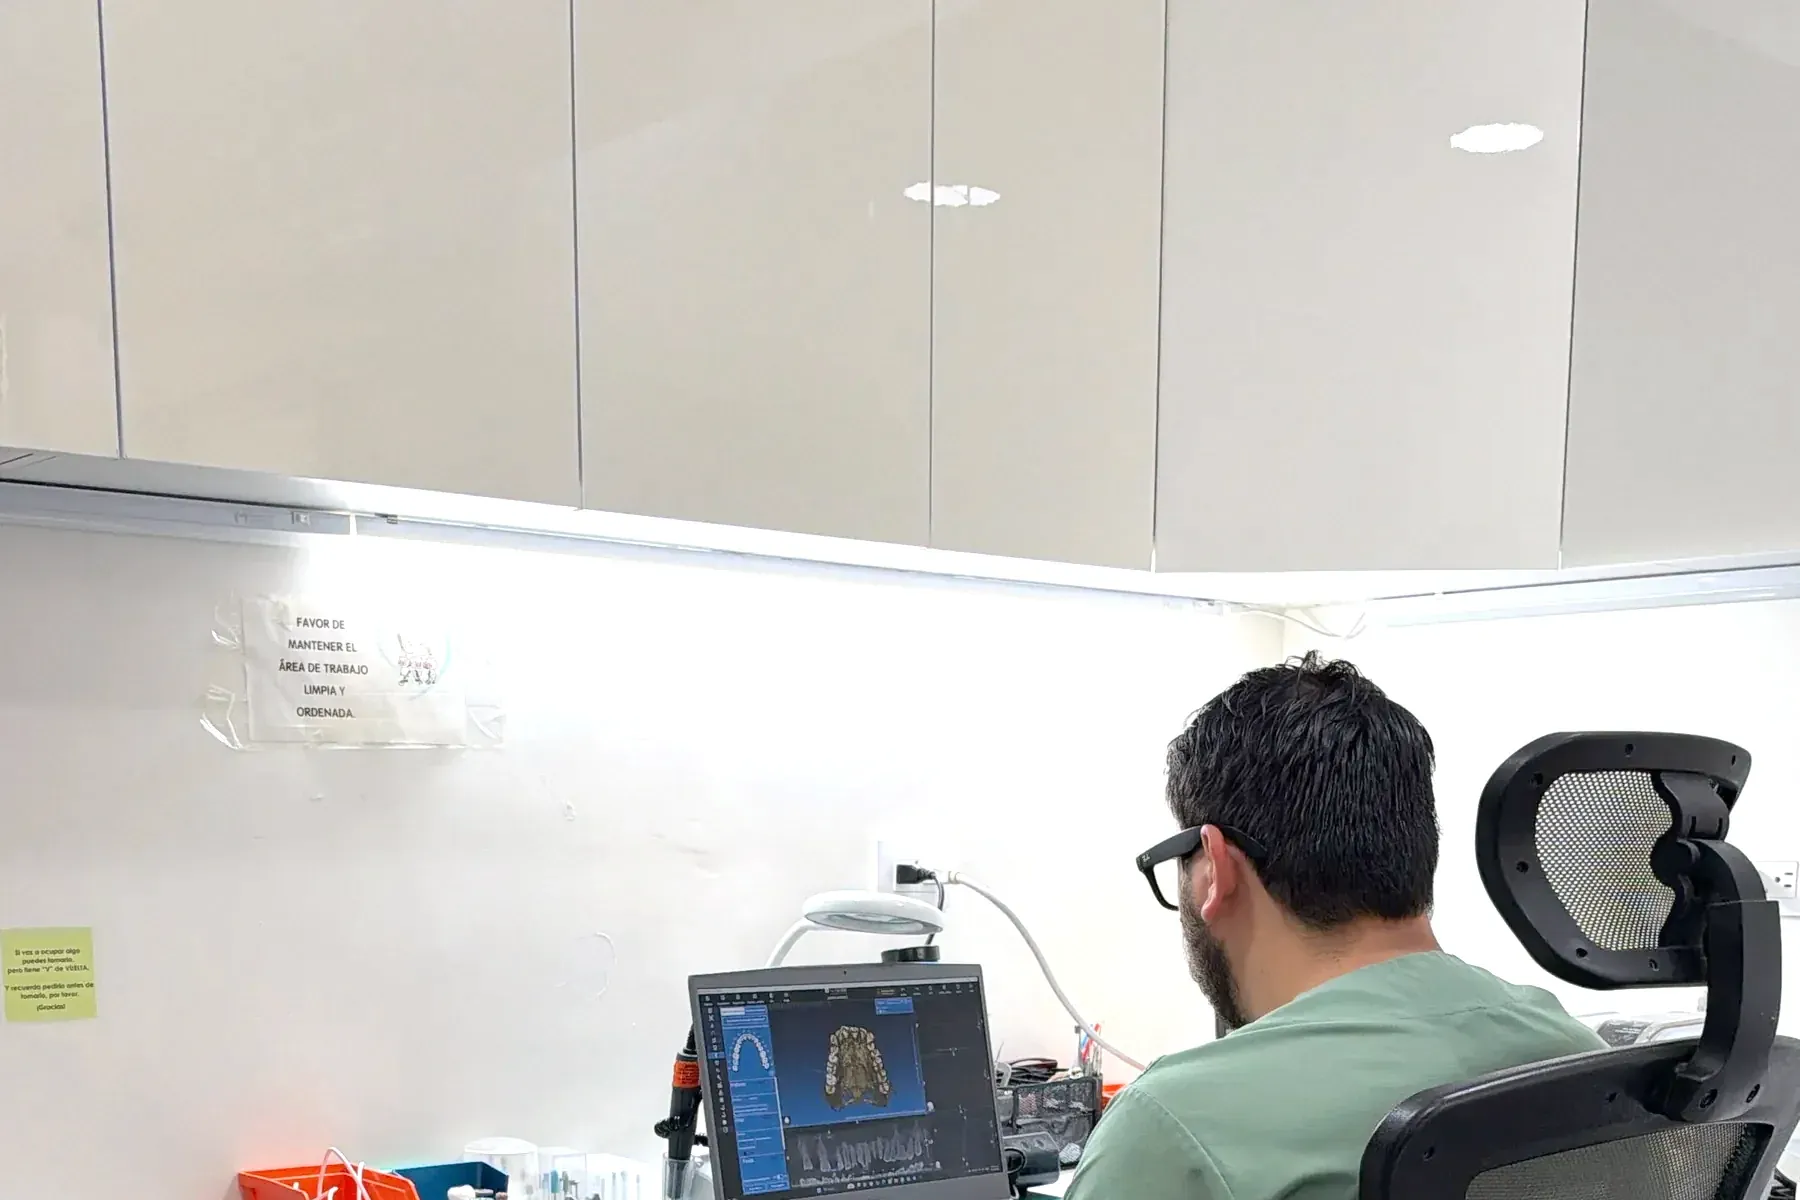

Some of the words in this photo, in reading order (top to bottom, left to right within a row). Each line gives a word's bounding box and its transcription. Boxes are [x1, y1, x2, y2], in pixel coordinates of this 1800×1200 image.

[296, 617, 330, 629] FAVOR
[332, 619, 345, 630] DE
[288, 639, 344, 652] MANTENER
[345, 642, 357, 653] EL
[279, 658, 306, 672] ÁREA
[307, 662, 321, 673] DE
[323, 663, 369, 675] TRABAJO
[303, 684, 337, 696] LIMPIA
[339, 686, 346, 696] Y
[7, 967, 23, 975] pero
